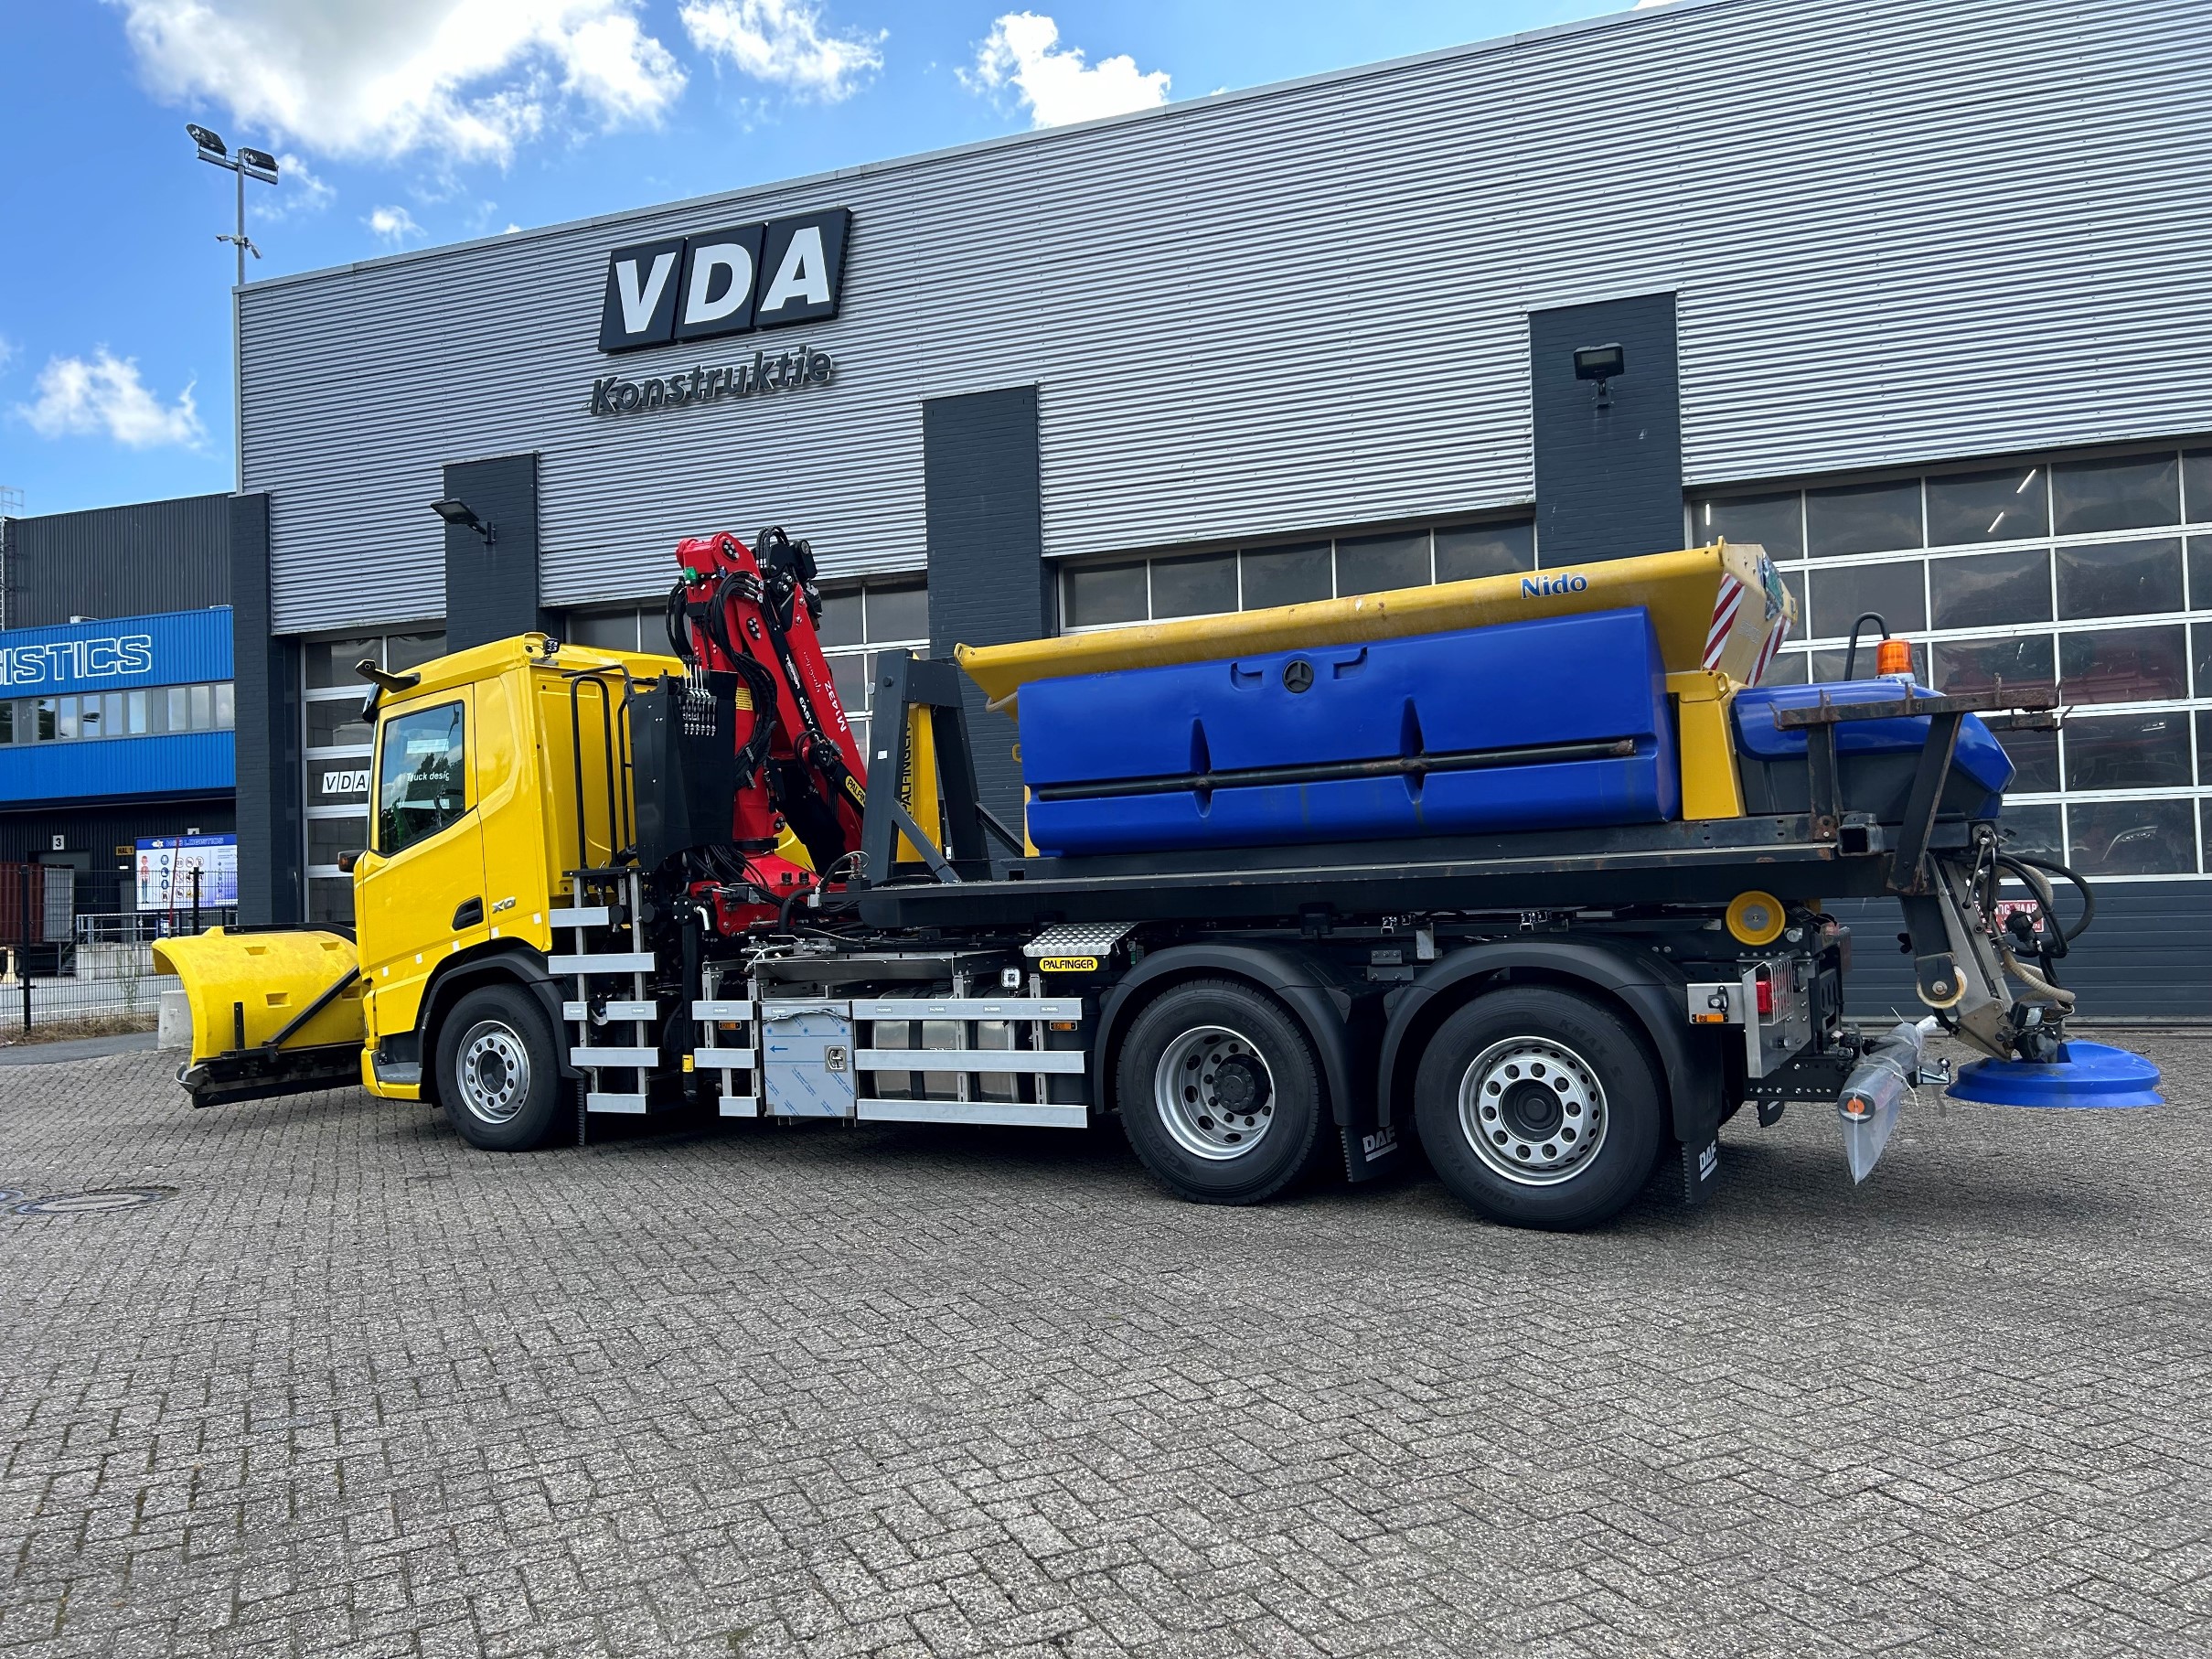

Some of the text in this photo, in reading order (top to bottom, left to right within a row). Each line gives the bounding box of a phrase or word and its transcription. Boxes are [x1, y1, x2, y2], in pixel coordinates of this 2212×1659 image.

[614, 225, 830, 335] VDA
[590, 344, 835, 415] Konstruktie
[1520, 572, 1588, 600] Nido
[0, 634, 152, 686] ISTICS
[326, 774, 367, 790] VDA
[406, 772, 428, 782] Truck
[55, 837, 62, 848] 3
[1042, 958, 1095, 969] PALFINGER
[1362, 1124, 1395, 1154] DAF
[1698, 1139, 1717, 1172] DAF
